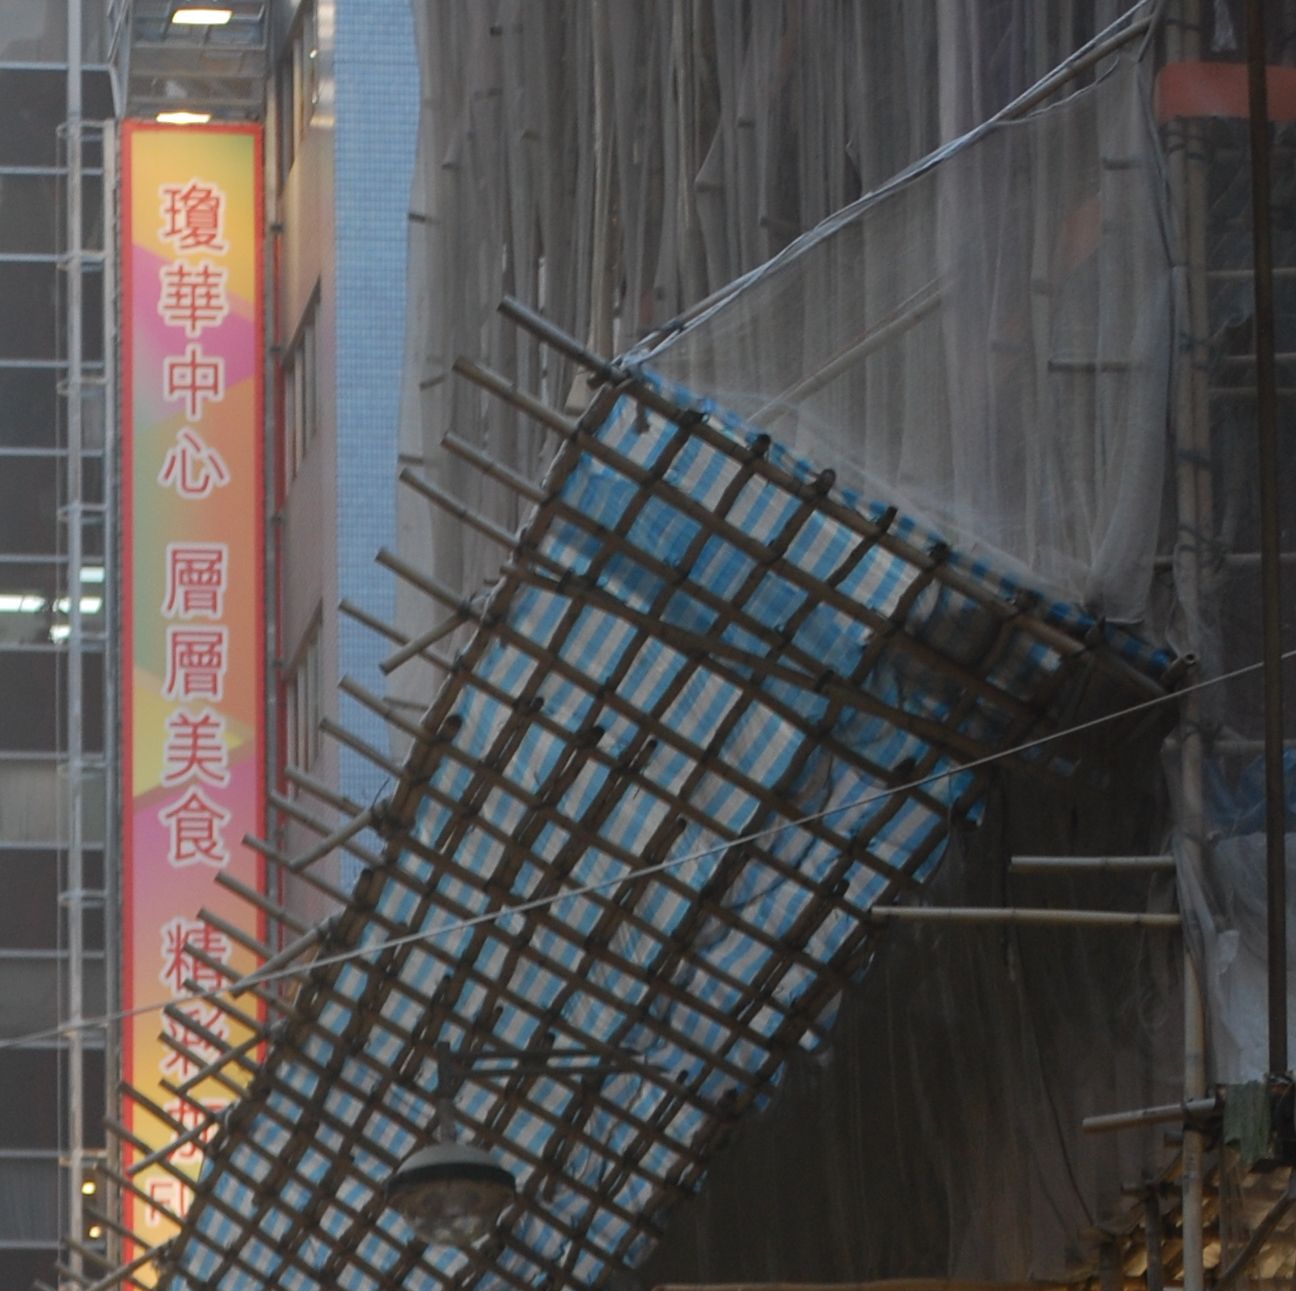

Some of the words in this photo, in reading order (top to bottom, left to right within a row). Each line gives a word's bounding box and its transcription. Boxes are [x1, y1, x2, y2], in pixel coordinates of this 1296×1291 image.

[161, 184, 227, 496] 瓊華中心
[161, 547, 228, 867] 層層美食
